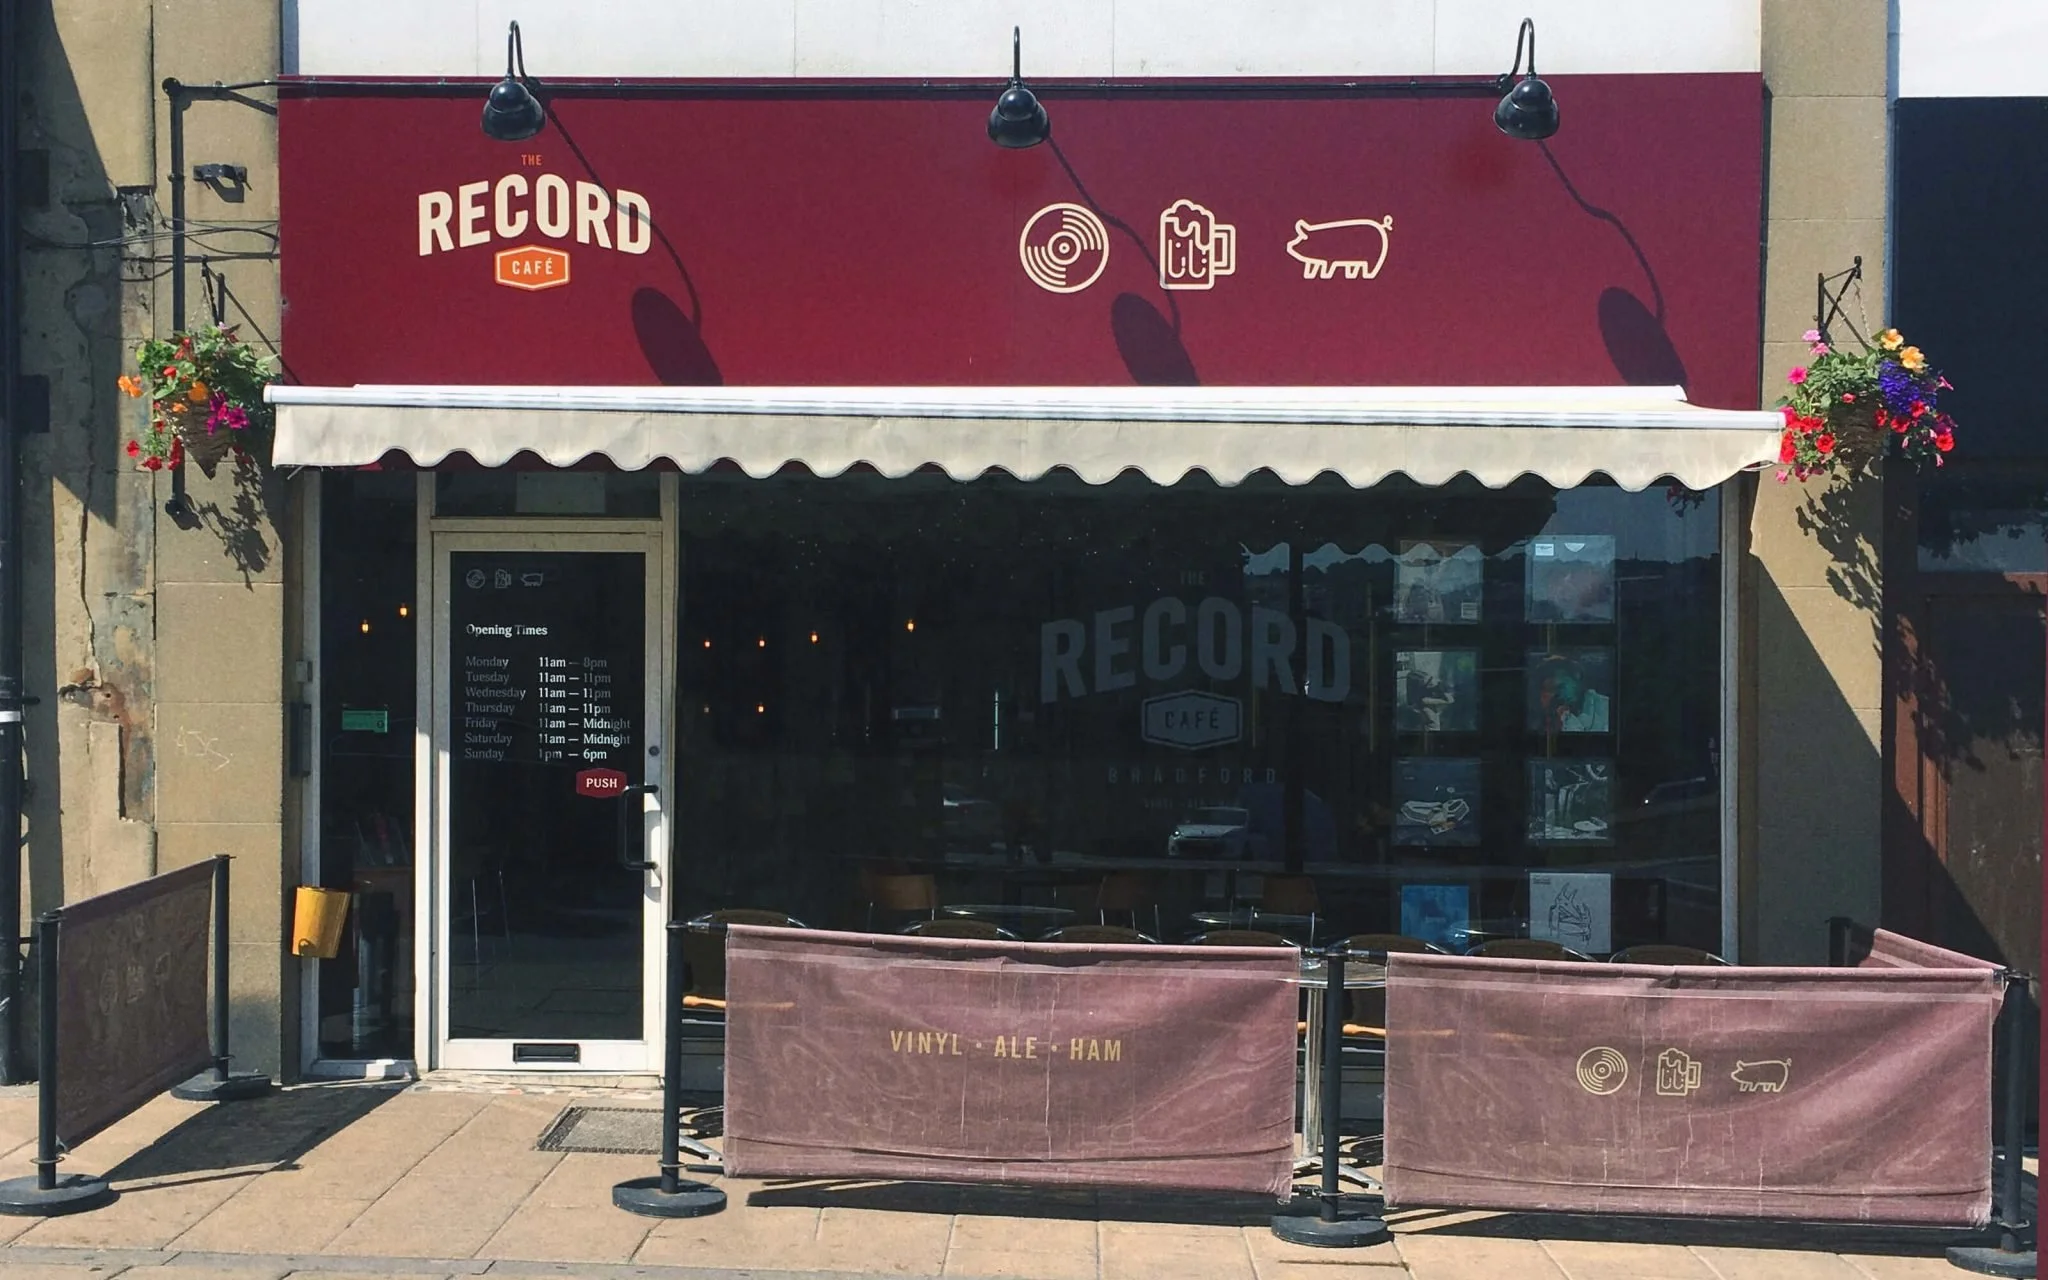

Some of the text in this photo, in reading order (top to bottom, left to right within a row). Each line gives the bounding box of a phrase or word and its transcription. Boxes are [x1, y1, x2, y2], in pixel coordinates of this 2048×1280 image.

[521, 154, 543, 166] THE
[418, 173, 651, 257] RECORD
[511, 257, 554, 275] CAFÉ
[466, 623, 549, 638] Opening Times
[1041, 597, 1351, 704] RECORD
[465, 656, 509, 669] Monday
[539, 656, 567, 668] 11am
[583, 656, 608, 670] 8pm
[465, 671, 510, 684] Tuesday
[539, 672, 566, 683] 11am
[583, 672, 611, 685] 11pm
[465, 687, 526, 700] Wednesday
[538, 687, 566, 698] 11am
[583, 687, 611, 700] 11pm
[465, 701, 516, 715] Thursday
[538, 703, 566, 714] 11am
[583, 702, 611, 716] 11pm
[465, 717, 498, 730] Friday
[538, 718, 566, 729] 11am
[583, 717, 631, 731] Midnight
[1164, 706, 1220, 730] CAFÉ
[464, 733, 513, 746] Saturday
[538, 733, 566, 744] 11am
[583, 733, 631, 747] Midnight
[464, 748, 504, 761] Sunday
[538, 748, 563, 761] 1pm
[583, 748, 607, 762] 6pm
[586, 778, 617, 788] PUSH
[890, 1030, 963, 1056] VINYL
[994, 1035, 1038, 1059] ALE
[1070, 1038, 1121, 1061] HAM
